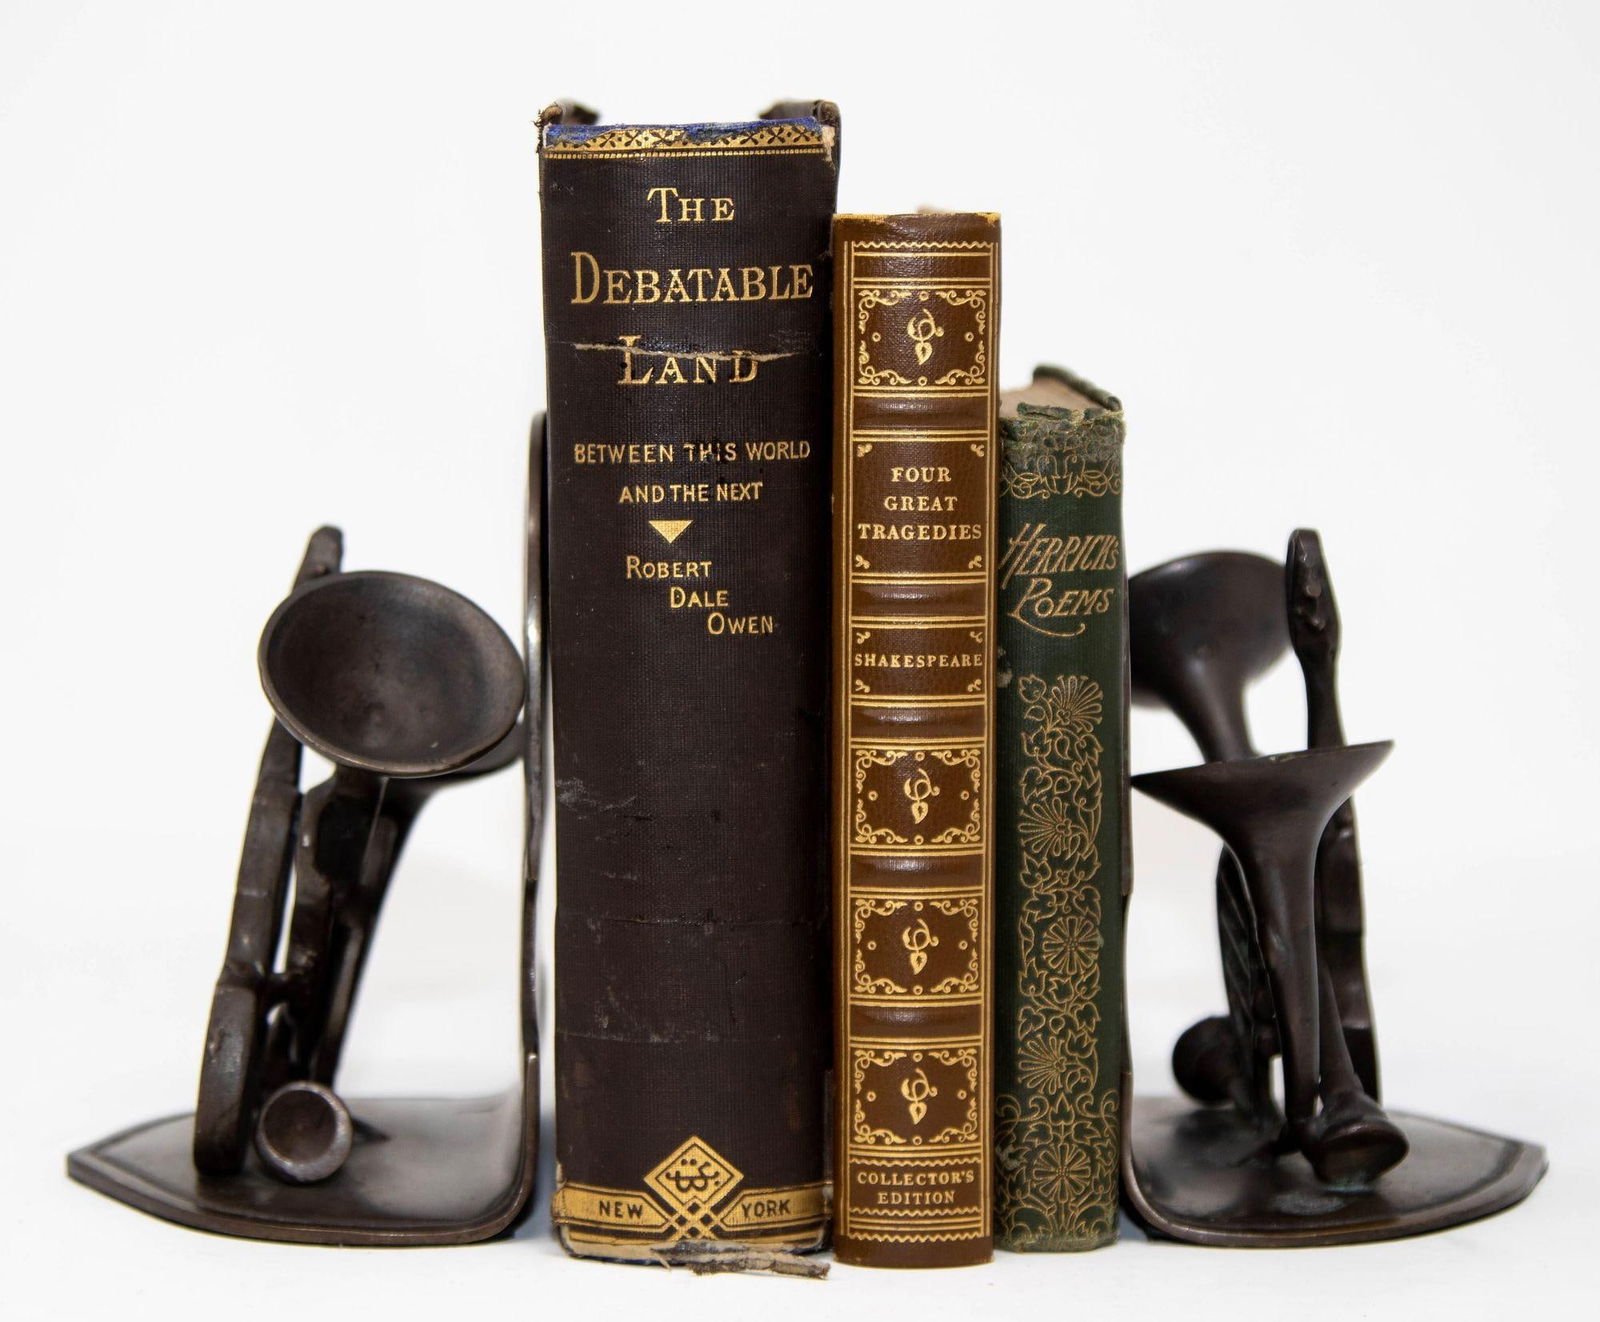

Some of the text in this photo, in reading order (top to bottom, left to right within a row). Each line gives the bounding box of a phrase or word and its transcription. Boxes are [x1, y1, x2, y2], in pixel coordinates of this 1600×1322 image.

[647, 187, 735, 223] THE
[570, 251, 813, 304] DEBATABLE
[617, 335, 759, 385] LAND
[574, 441, 811, 464] BETWEEN THIS WORLD
[891, 467, 952, 483] FOUR
[619, 482, 763, 504] AND THE NEXT
[883, 496, 958, 512] GREAT
[858, 523, 982, 540] TRAGEDIES
[626, 555, 713, 579] ROBERT
[669, 586, 729, 609] DALE
[707, 612, 774, 635] OWEN
[854, 653, 983, 668] SHAKESPEARE
[857, 1170, 975, 1186] COLLECTOR'S
[599, 1199, 791, 1218] NEW YORK
[877, 1191, 956, 1205] EDITION
